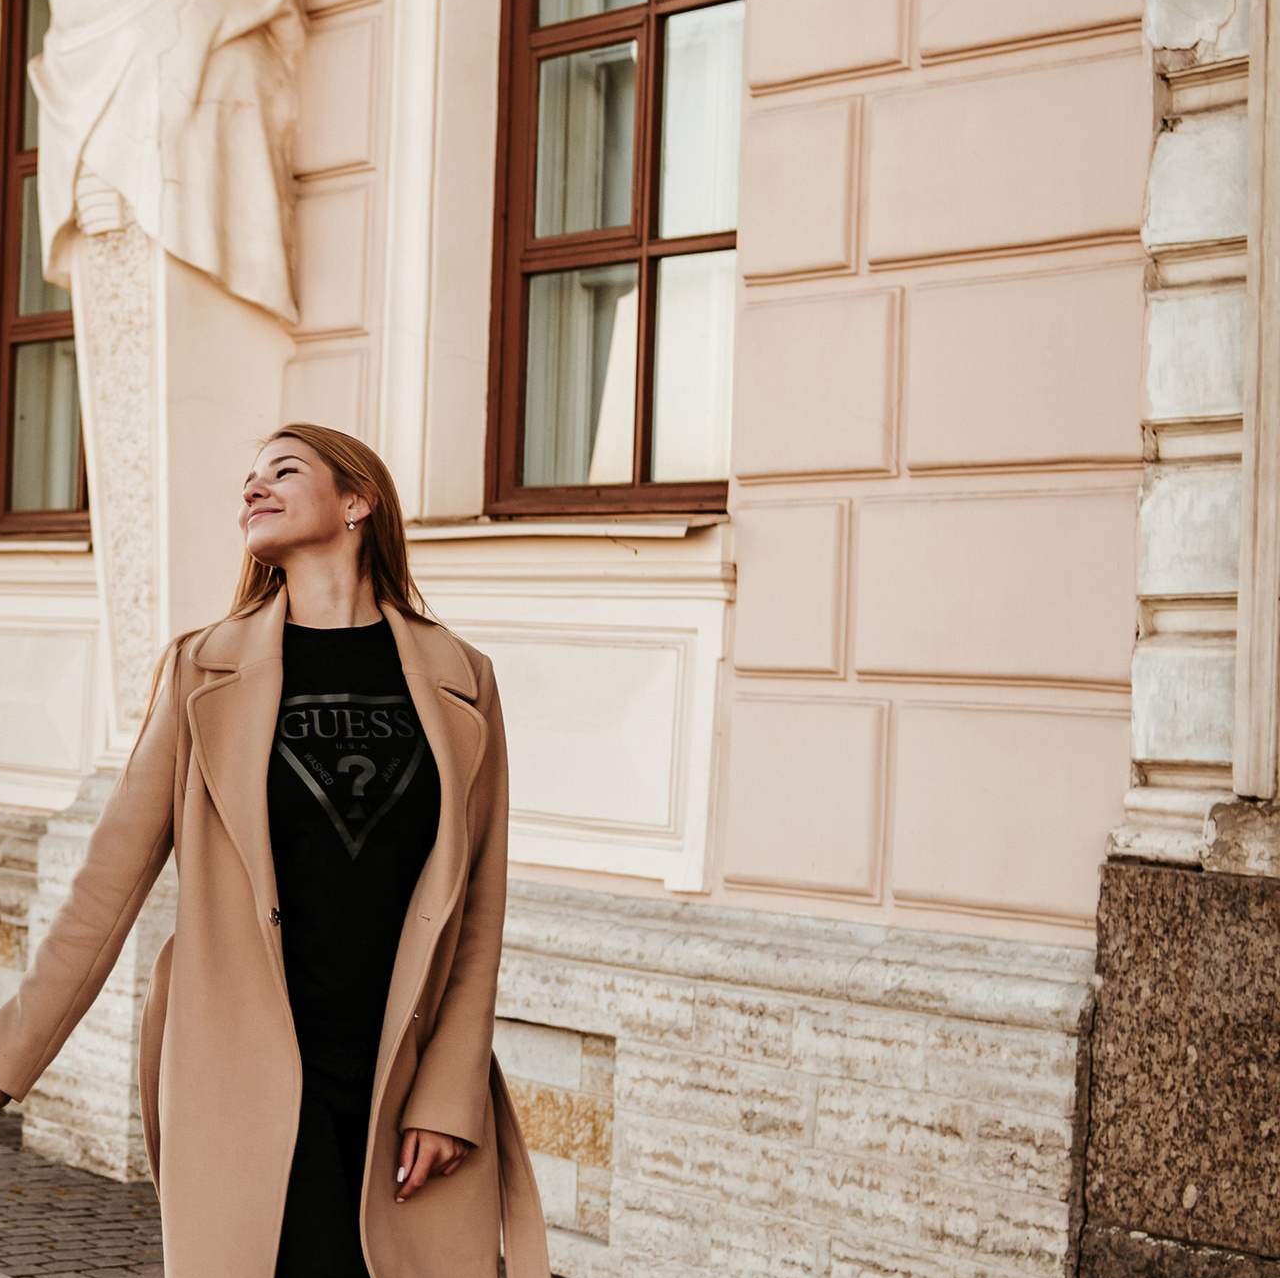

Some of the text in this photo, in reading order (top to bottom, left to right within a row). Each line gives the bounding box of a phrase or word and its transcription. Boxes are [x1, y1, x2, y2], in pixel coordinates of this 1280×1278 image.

[279, 708, 415, 740] GUESS
[303, 752, 335, 786] WASHED
[381, 757, 401, 783] JEANS
